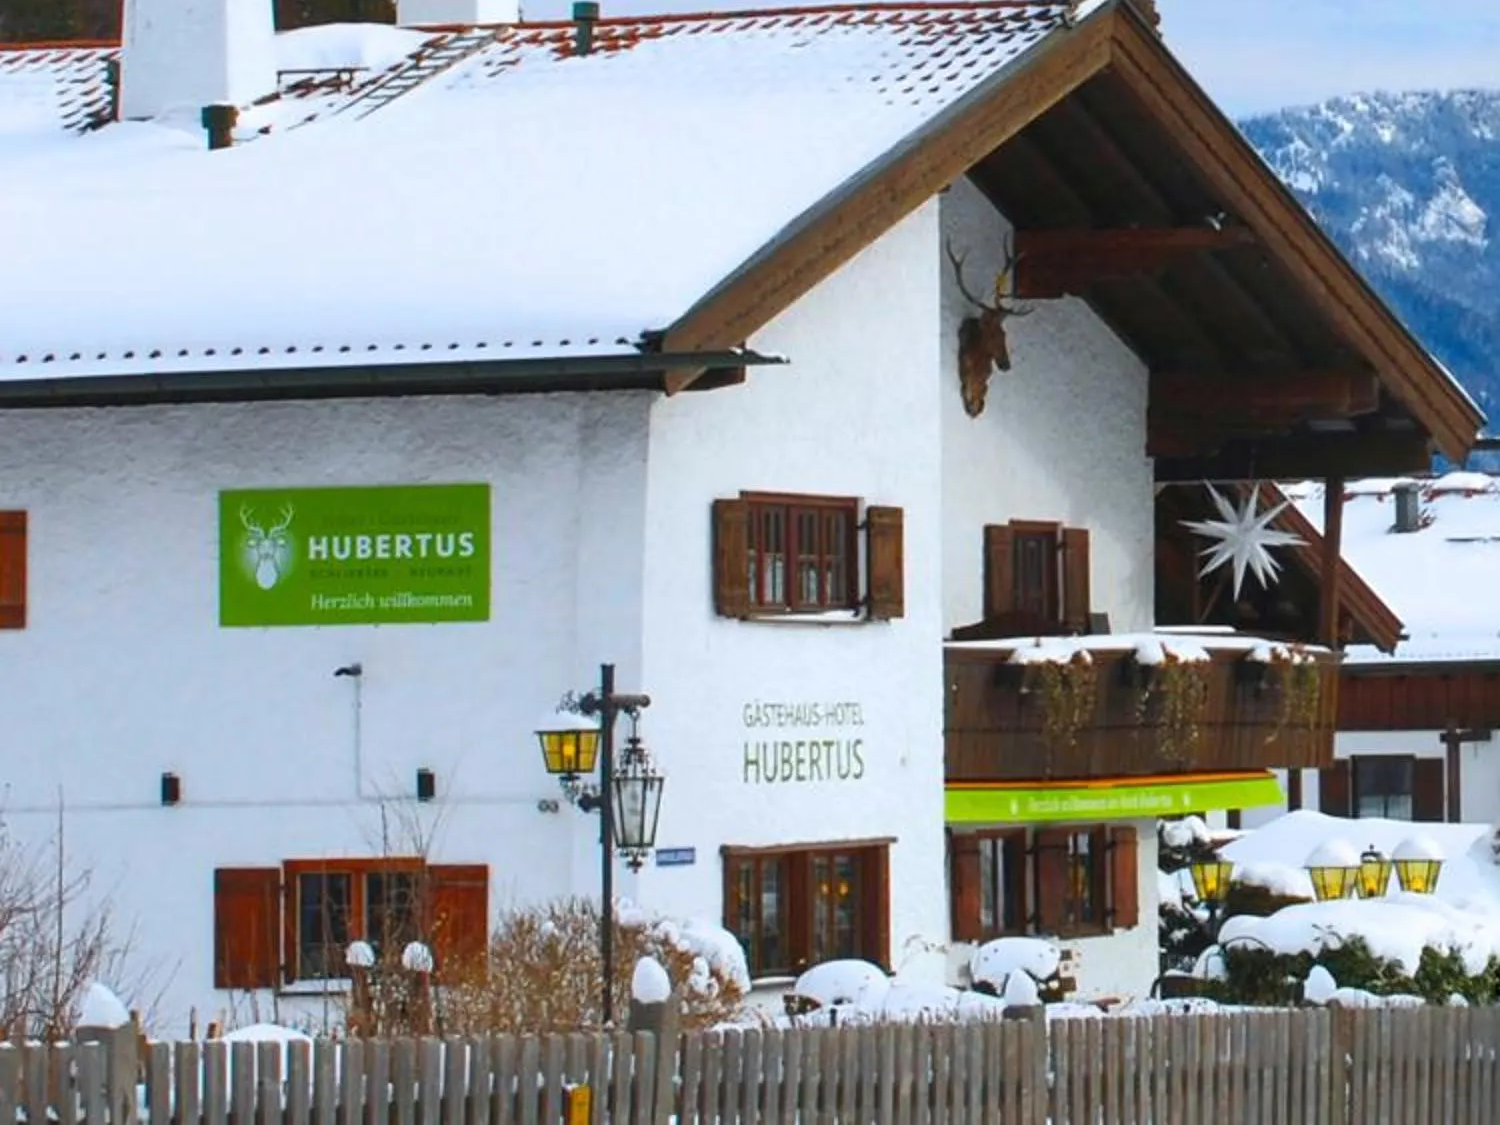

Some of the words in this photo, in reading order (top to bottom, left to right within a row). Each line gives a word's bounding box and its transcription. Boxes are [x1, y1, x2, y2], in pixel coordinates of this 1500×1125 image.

[308, 532, 475, 560] HUBERTUS
[311, 591, 375, 611] Herzlich
[379, 590, 473, 609] willkommen
[742, 700, 864, 728] GÄSTEHAUS-HOTEL
[742, 739, 864, 784] HUBERTUS
